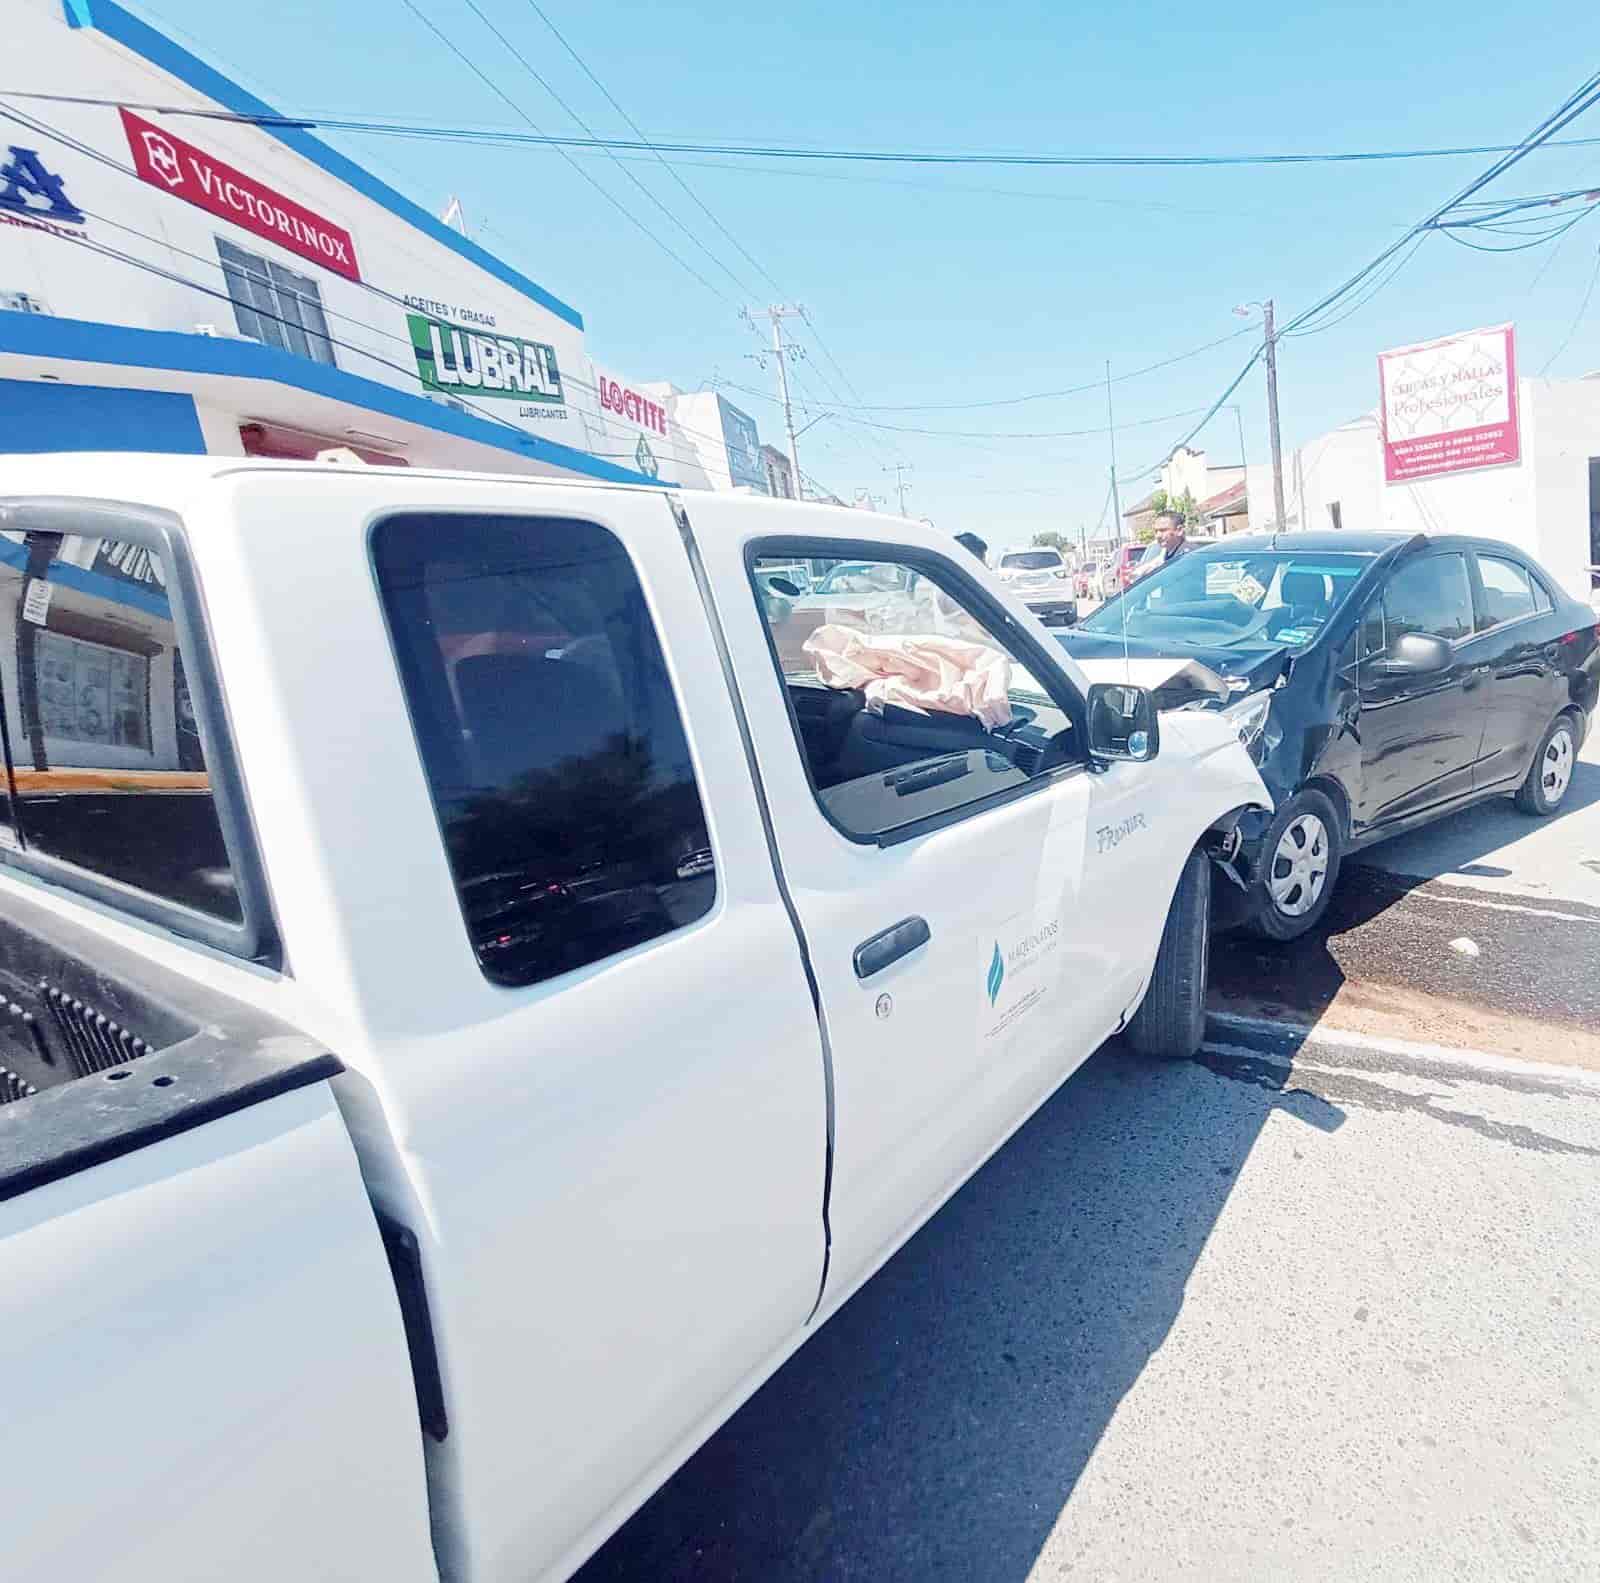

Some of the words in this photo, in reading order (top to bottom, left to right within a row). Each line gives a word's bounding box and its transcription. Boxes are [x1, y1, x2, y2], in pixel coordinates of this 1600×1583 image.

[188, 156, 350, 265] VICTORINOX
[402, 294, 449, 316] ACEITES
[451, 305, 458, 318] Y
[459, 308, 497, 328] GRASAS
[428, 323, 562, 397] LUBRAL
[1451, 362, 1504, 384] MALLAS
[519, 406, 569, 421] LUBRICANTES
[600, 374, 668, 436] LOCTITE
